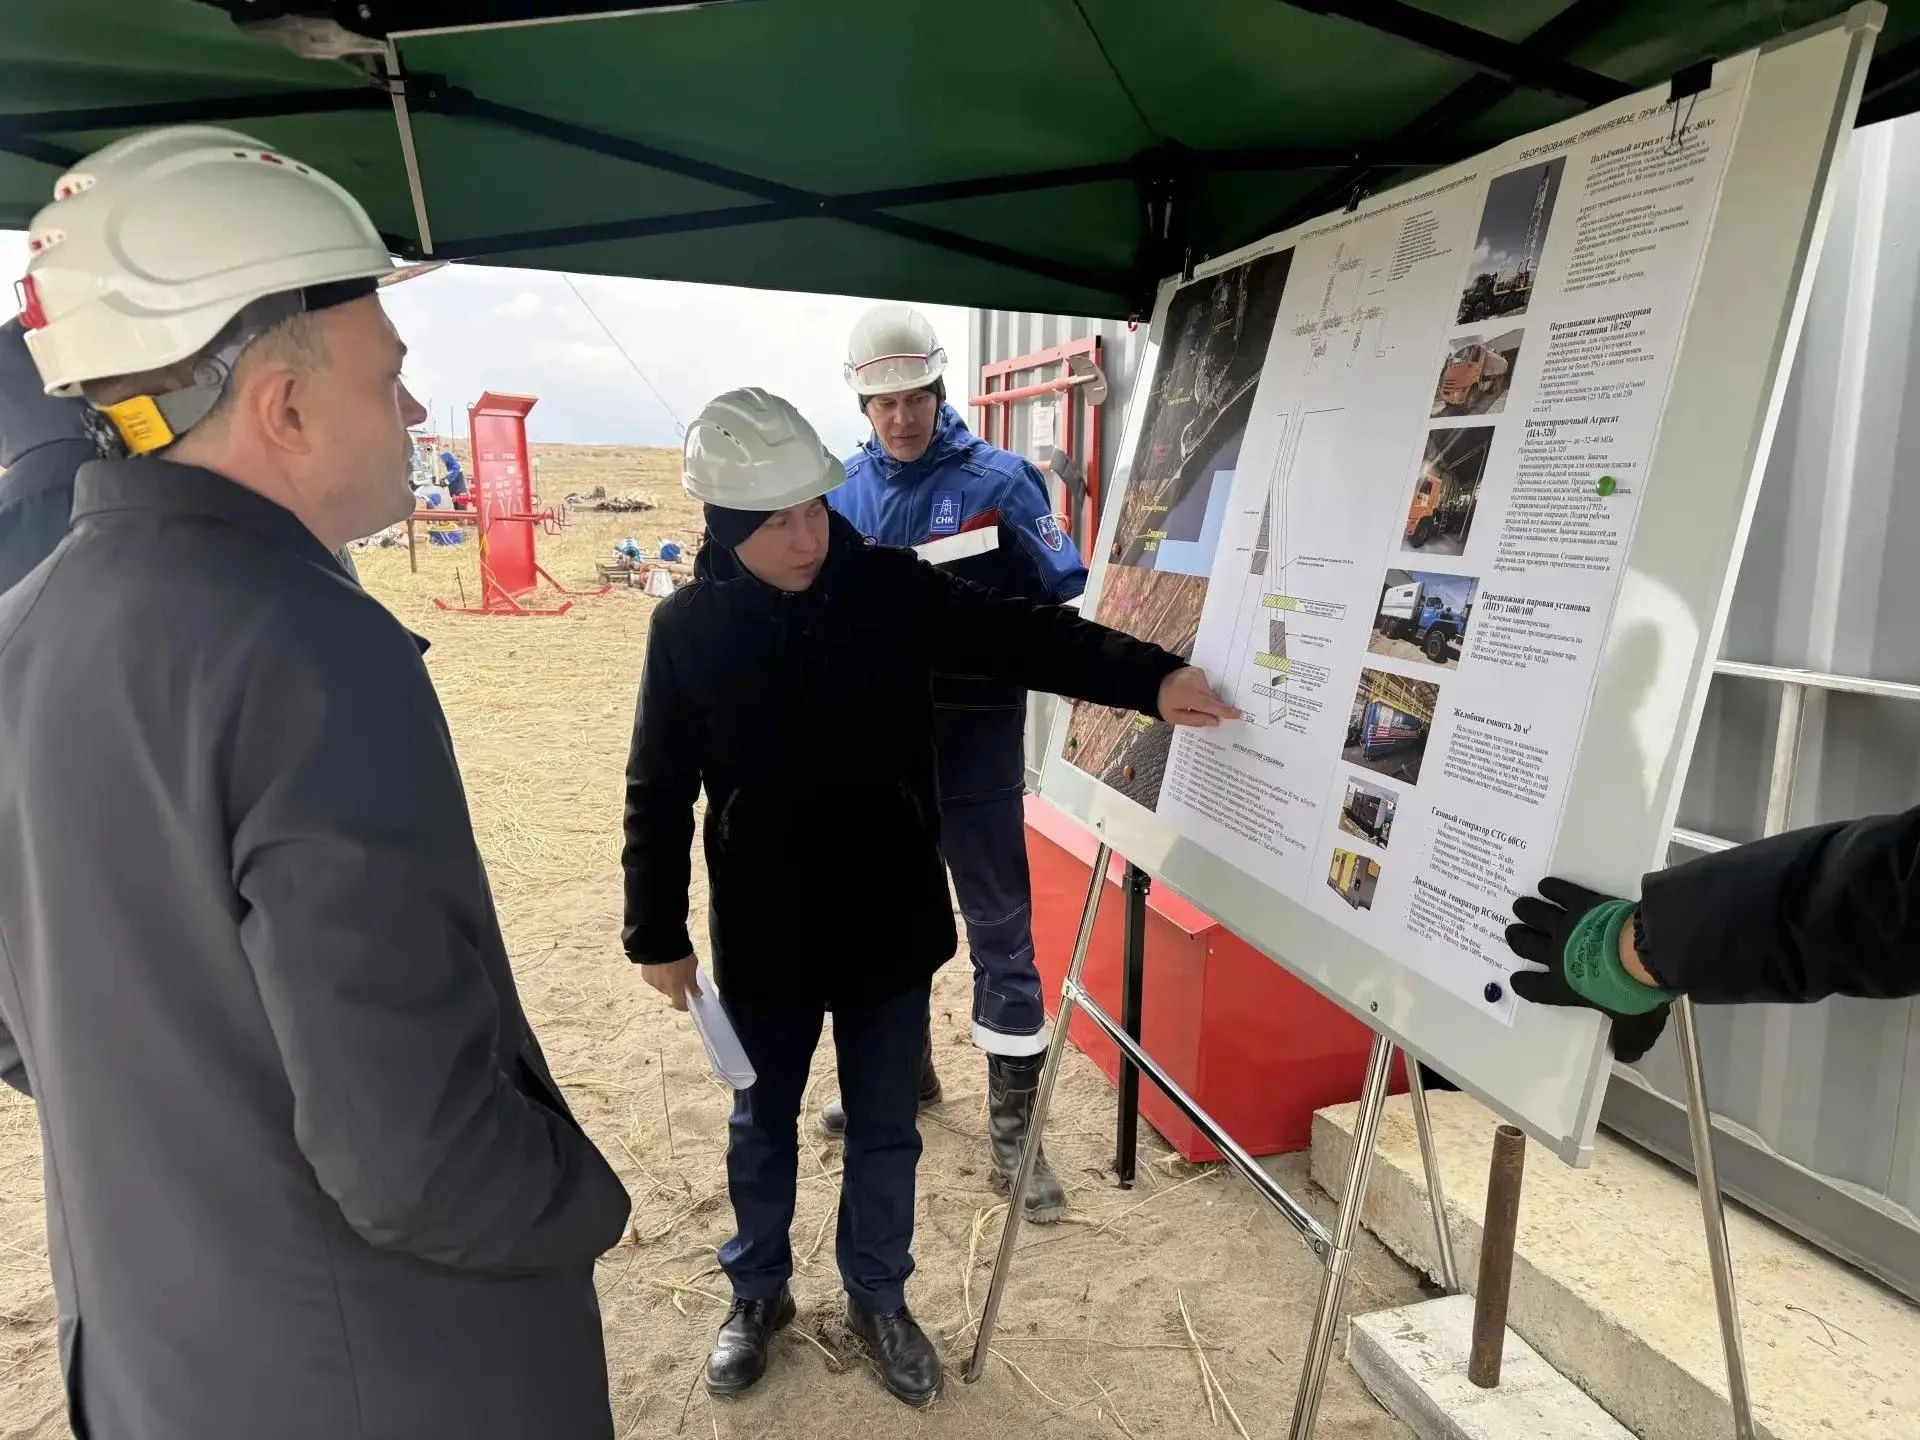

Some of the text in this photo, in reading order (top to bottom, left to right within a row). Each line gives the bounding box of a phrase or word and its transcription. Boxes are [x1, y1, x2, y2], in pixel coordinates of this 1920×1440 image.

[1519, 134, 1578, 160] ОБОРУДОВАНИЕ
[1577, 113, 1635, 141] ПРИМЕНЯЕМОЕ
[1638, 105, 1659, 119] ПРИ
[1633, 136, 1664, 150] агрегат
[1549, 308, 1652, 331] Передвижная компрессорная
[1551, 331, 1578, 341] азотная
[1578, 326, 1608, 337] станция
[1609, 320, 1631, 332] 10/250
[1525, 416, 1620, 428] Цементировочный Агрегат
[1526, 428, 1557, 438] (ЦА-320)
[935, 516, 954, 524] СНК
[1481, 591, 1591, 613] Передвижная паровая установка
[1483, 601, 1534, 616] (ППУ) 1600/100
[1453, 708, 1485, 723] Желобная
[1486, 718, 1512, 730] емкость
[1513, 723, 1522, 733] 20
[1431, 806, 1527, 850] Газовый генератор CTG 60CG
[1413, 875, 1447, 897] Дизельный
[1448, 893, 1480, 914] генератор
